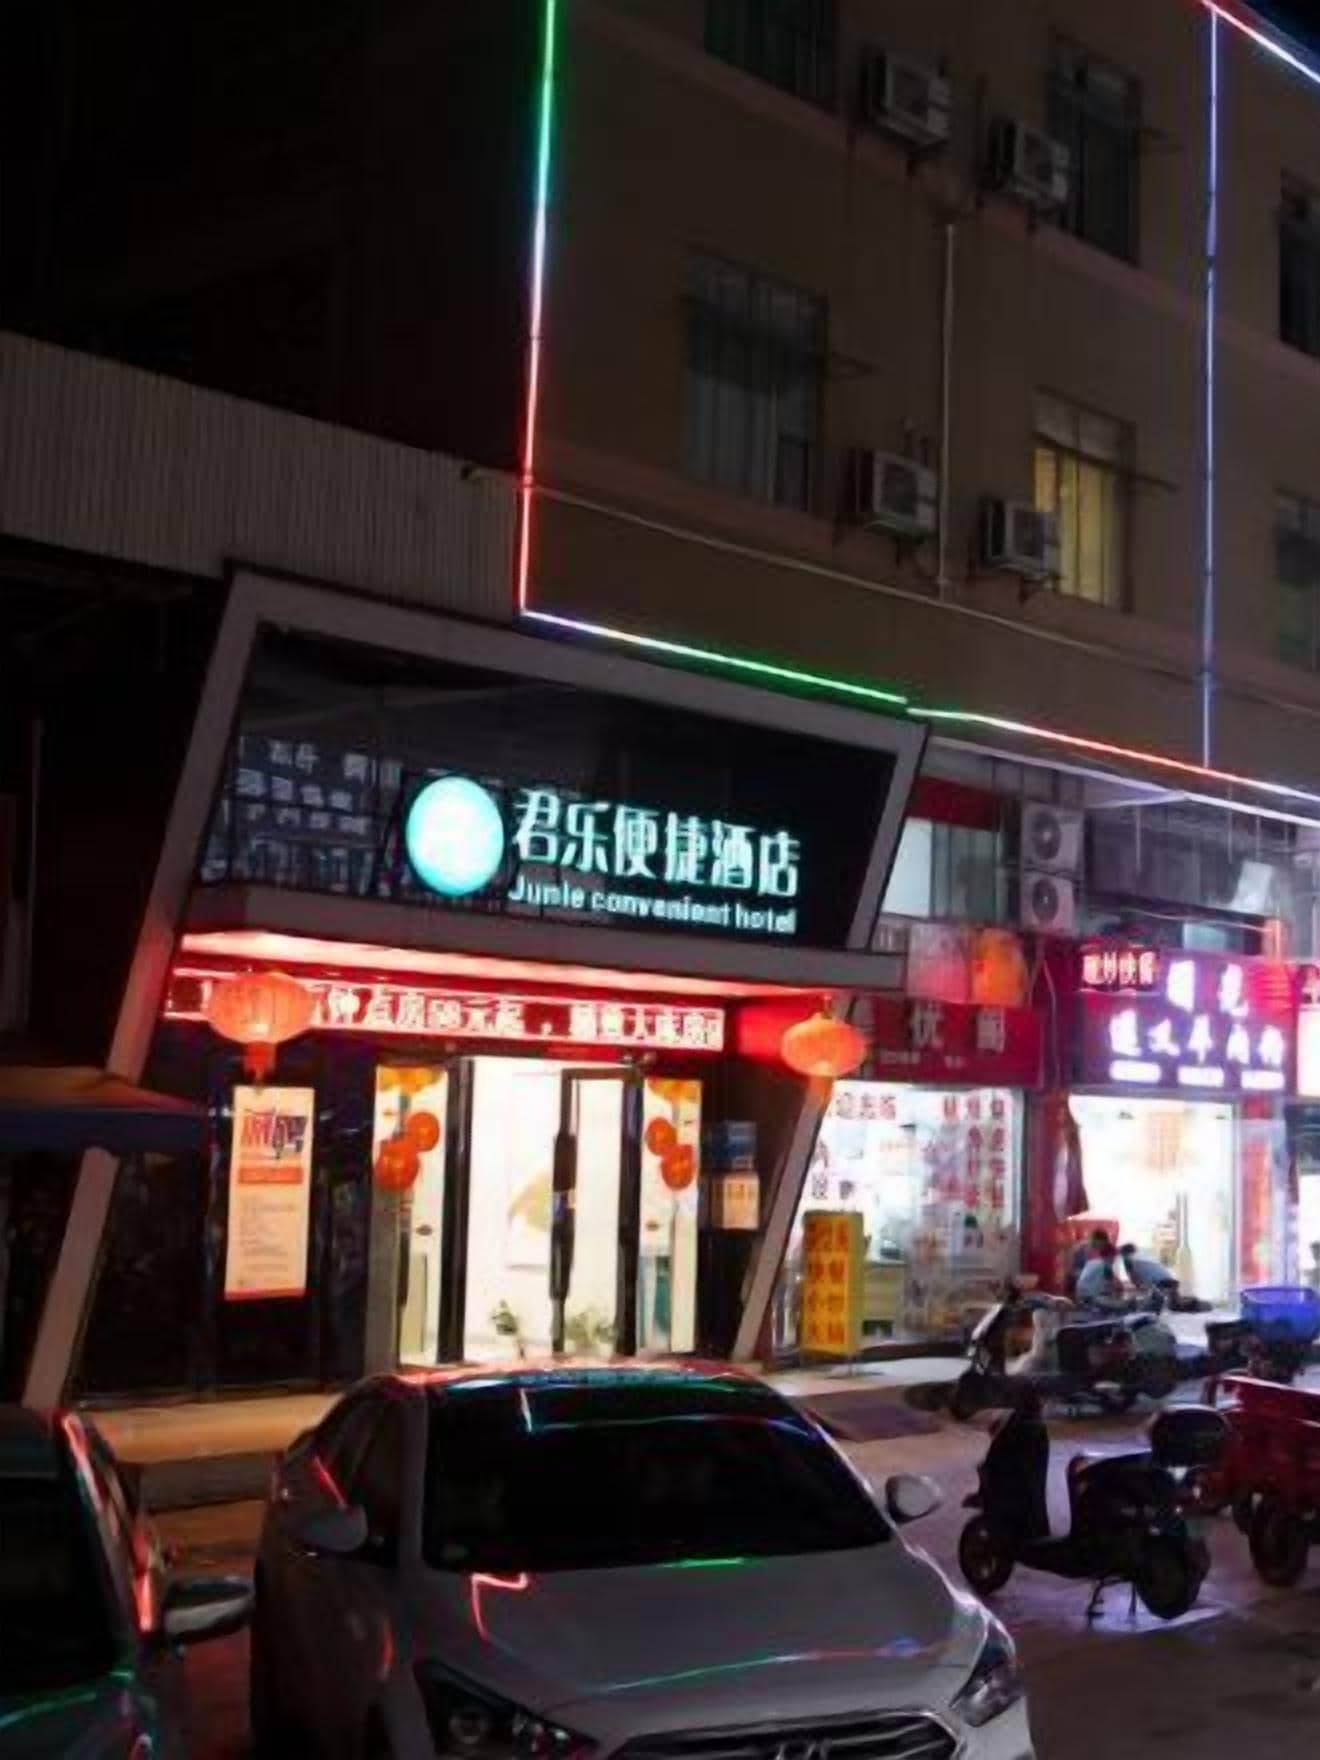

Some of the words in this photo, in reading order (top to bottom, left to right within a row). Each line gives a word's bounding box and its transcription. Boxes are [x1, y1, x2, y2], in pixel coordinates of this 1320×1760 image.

[513, 787, 800, 897] 君乐便捷酒店
[591, 889, 731, 927] convenient
[735, 902, 797, 934] hotel
